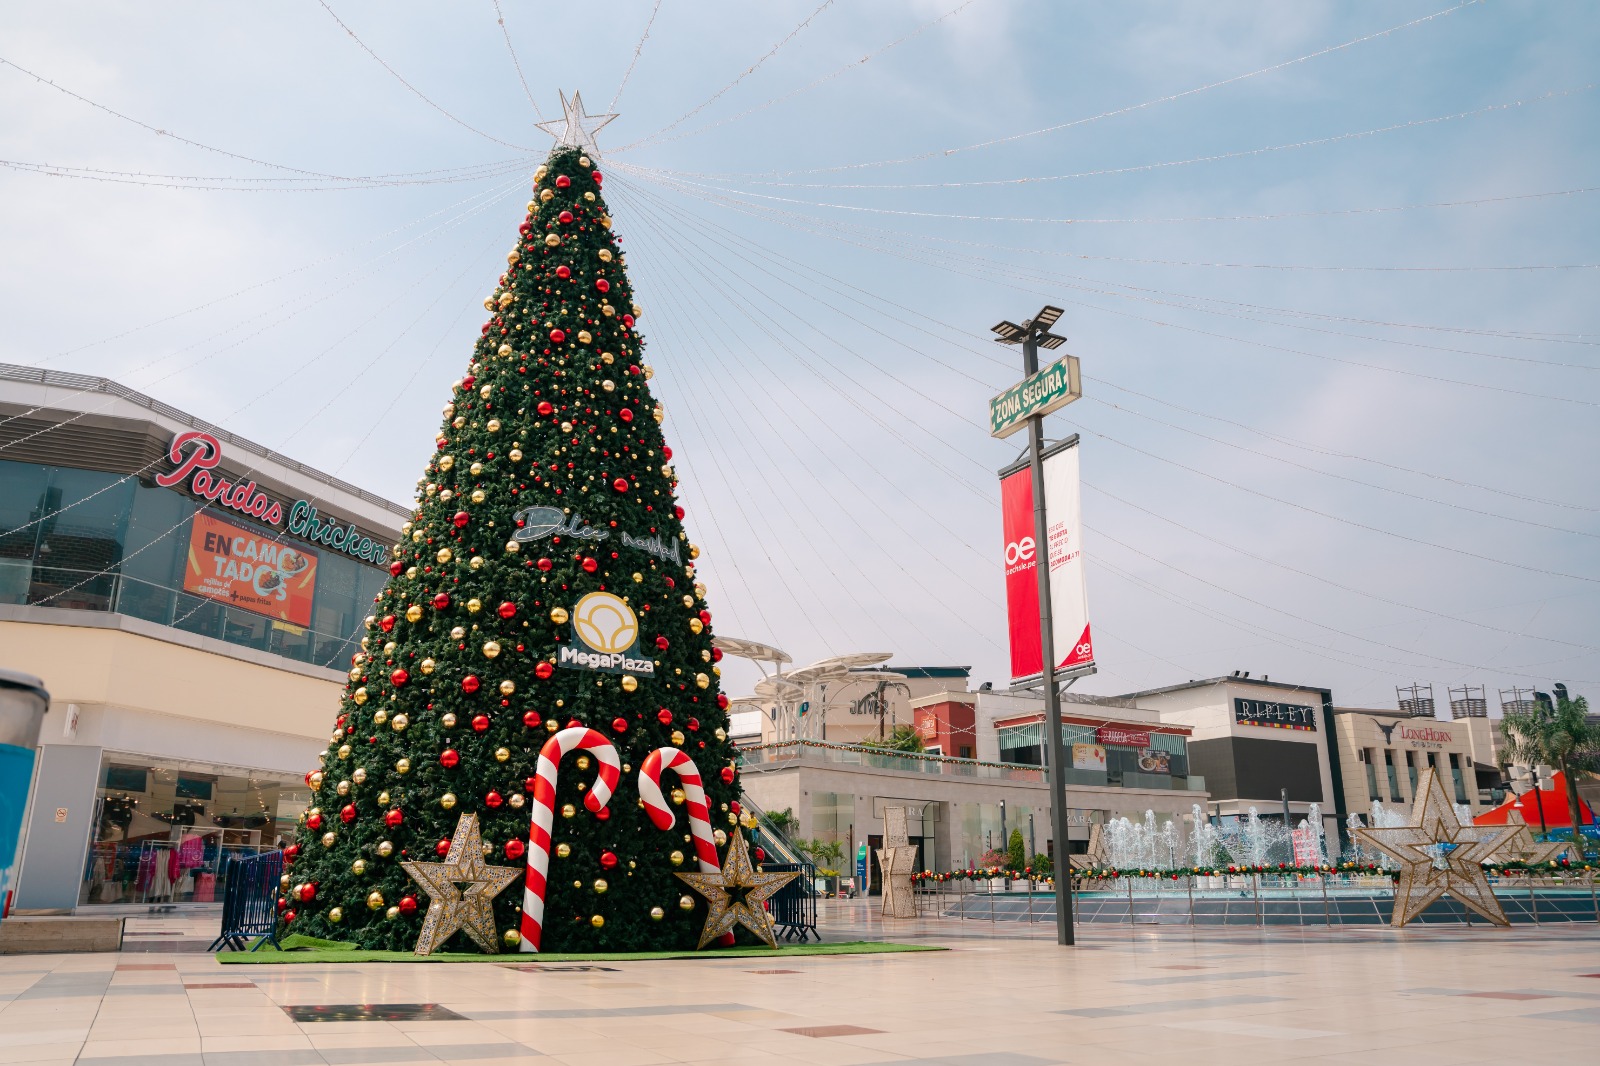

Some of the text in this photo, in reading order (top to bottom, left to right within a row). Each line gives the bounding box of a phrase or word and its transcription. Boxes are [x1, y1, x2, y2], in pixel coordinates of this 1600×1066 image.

[996, 371, 1062, 423] ZONA SEGURA
[156, 431, 386, 565] Pardos Chicken
[514, 506, 608, 541] Dulce
[1005, 536, 1036, 566] oe
[561, 646, 654, 673] MegaPlaza
[1076, 643, 1091, 655] oe
[1242, 701, 1308, 723] RIPLEY
[908, 807, 925, 817] RA
[1066, 815, 1093, 824] ZARA
